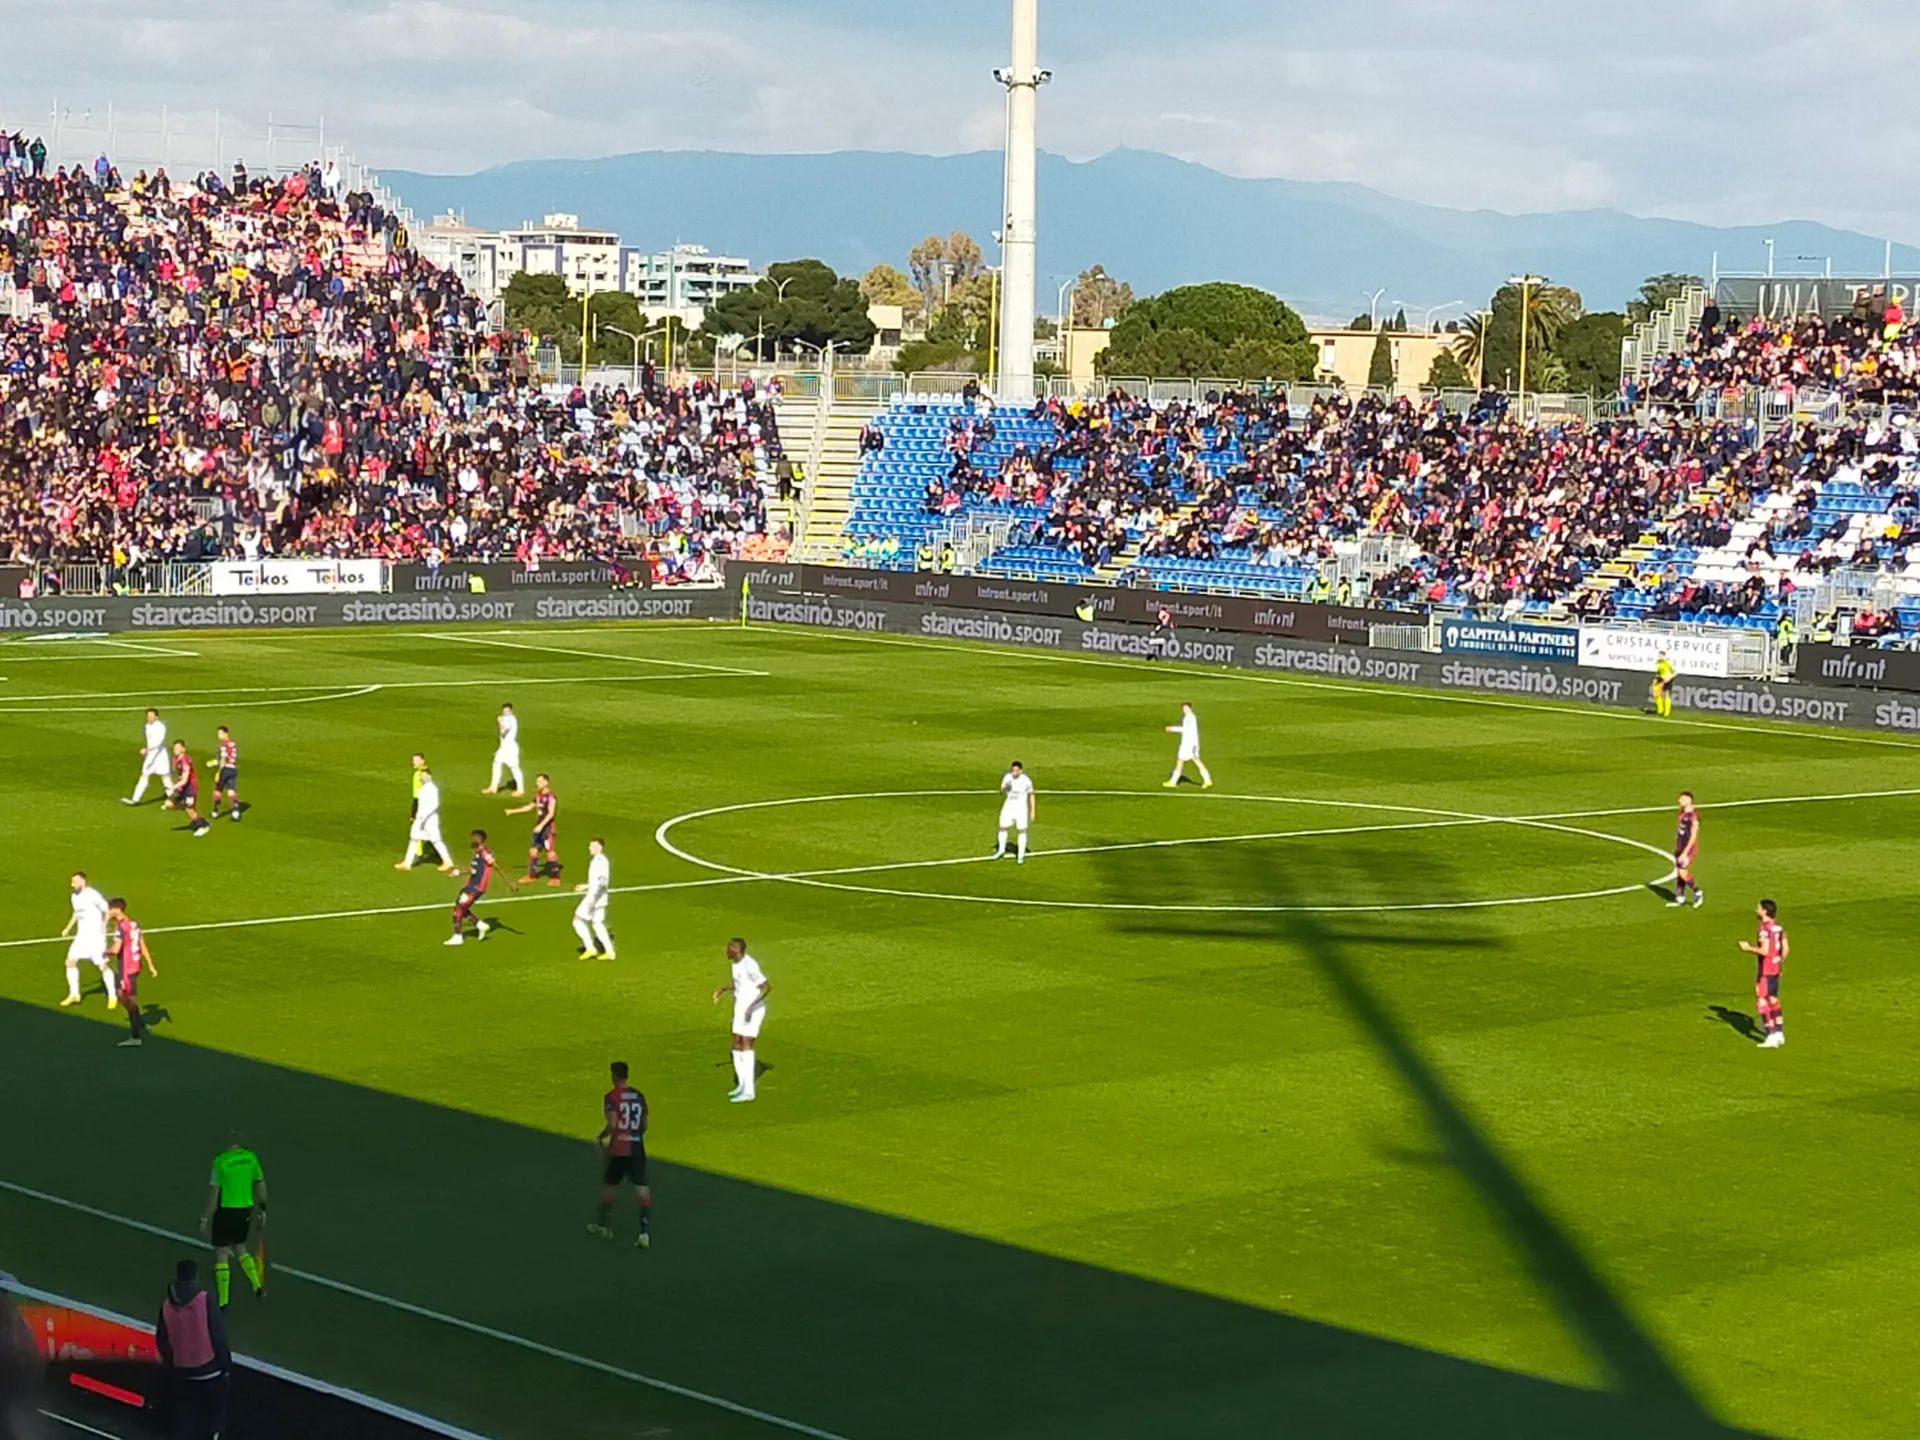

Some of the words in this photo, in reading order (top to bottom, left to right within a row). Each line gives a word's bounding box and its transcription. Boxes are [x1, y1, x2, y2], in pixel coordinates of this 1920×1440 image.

[1757, 284, 1819, 322] UNA
[229, 563, 289, 588] Teikos
[307, 562, 365, 588] Teikos
[744, 595, 887, 630] tarcasinò.SPORT
[1518, 631, 1575, 647] PARTNERS
[1606, 635, 1659, 650] CRISTAL
[1666, 639, 1721, 655] SERVICE
[617, 1102, 642, 1130] 33
